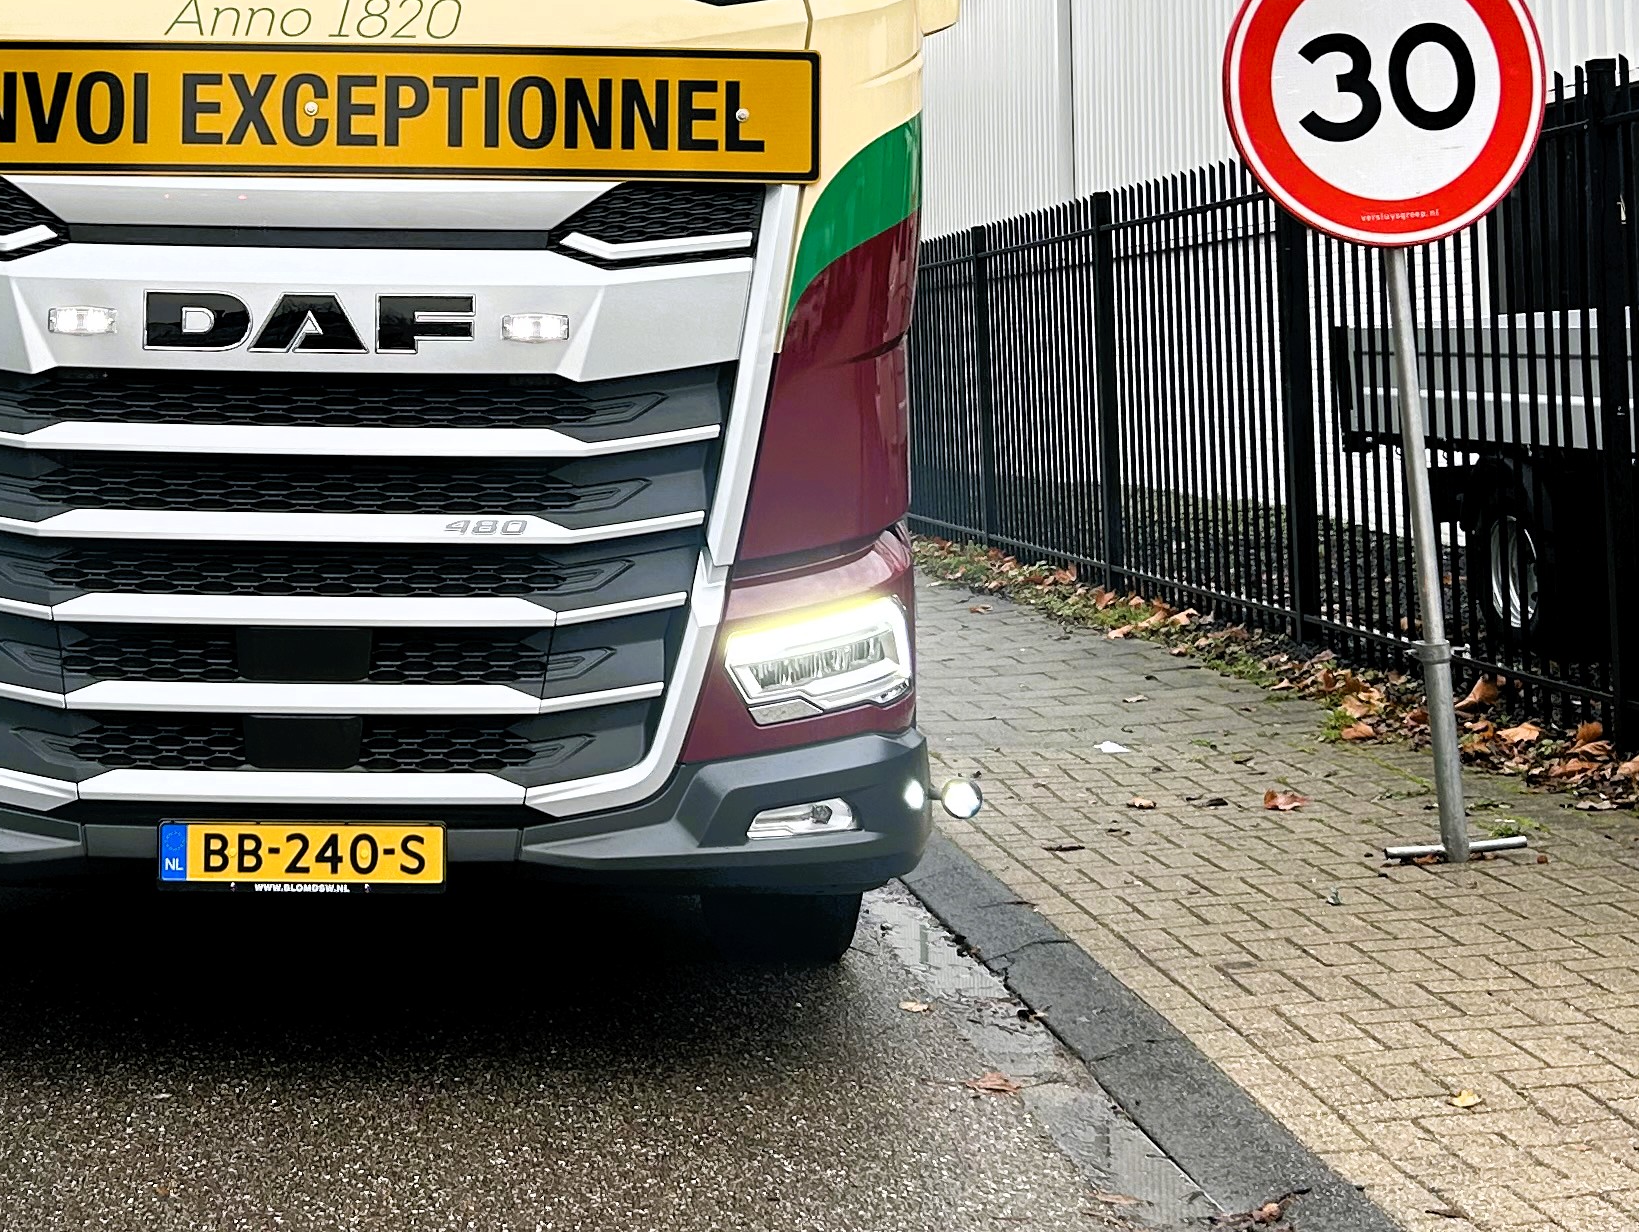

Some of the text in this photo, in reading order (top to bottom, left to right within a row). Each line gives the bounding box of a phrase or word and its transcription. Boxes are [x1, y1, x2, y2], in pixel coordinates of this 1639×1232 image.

[1298, 22, 1477, 142] 30
[181, 72, 766, 154] EXCEPTIONNEL
[143, 290, 477, 354] DAF
[444, 519, 528, 536] 480
[164, 857, 184, 871] NL
[203, 833, 426, 875] BB-240-S
